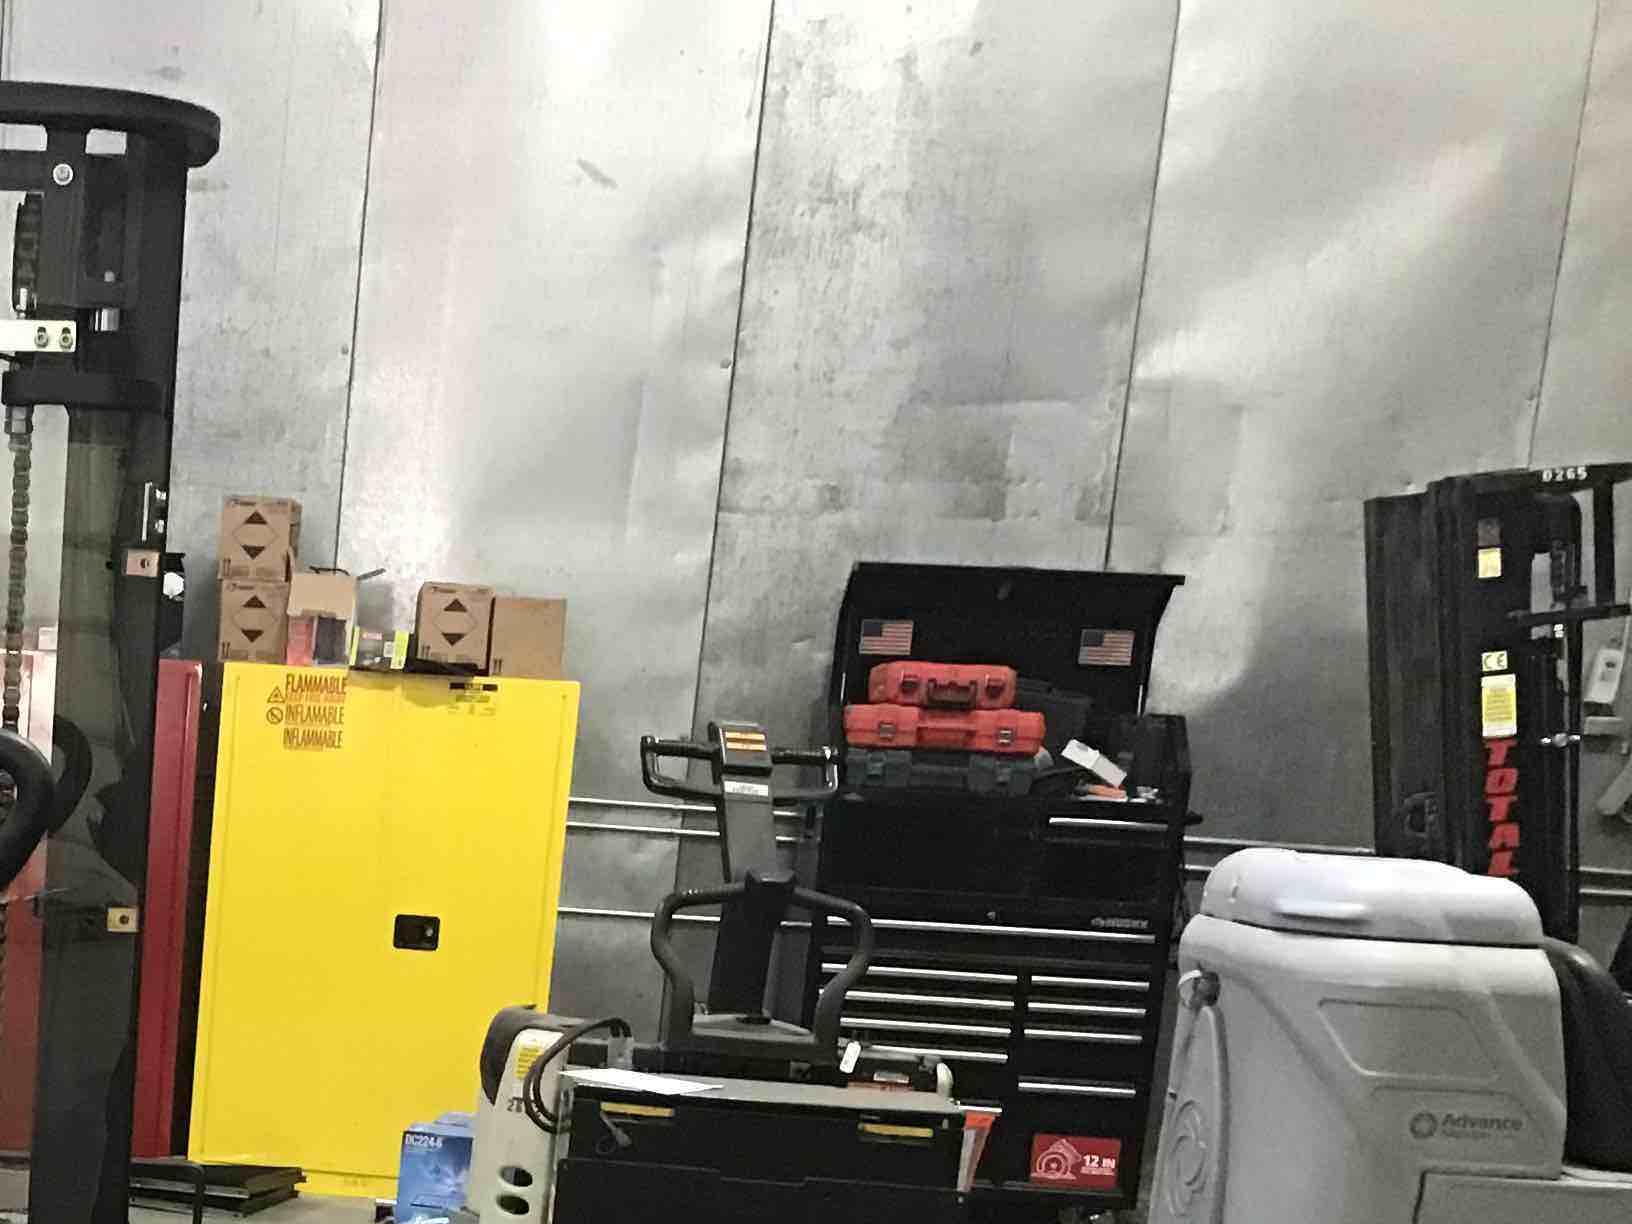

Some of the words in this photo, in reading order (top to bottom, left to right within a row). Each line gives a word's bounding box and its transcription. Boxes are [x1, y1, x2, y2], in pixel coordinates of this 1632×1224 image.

[1542, 465, 1588, 482] 0265
[285, 673, 347, 695] FLAMMABLE
[285, 703, 345, 725] INFLAMABLE
